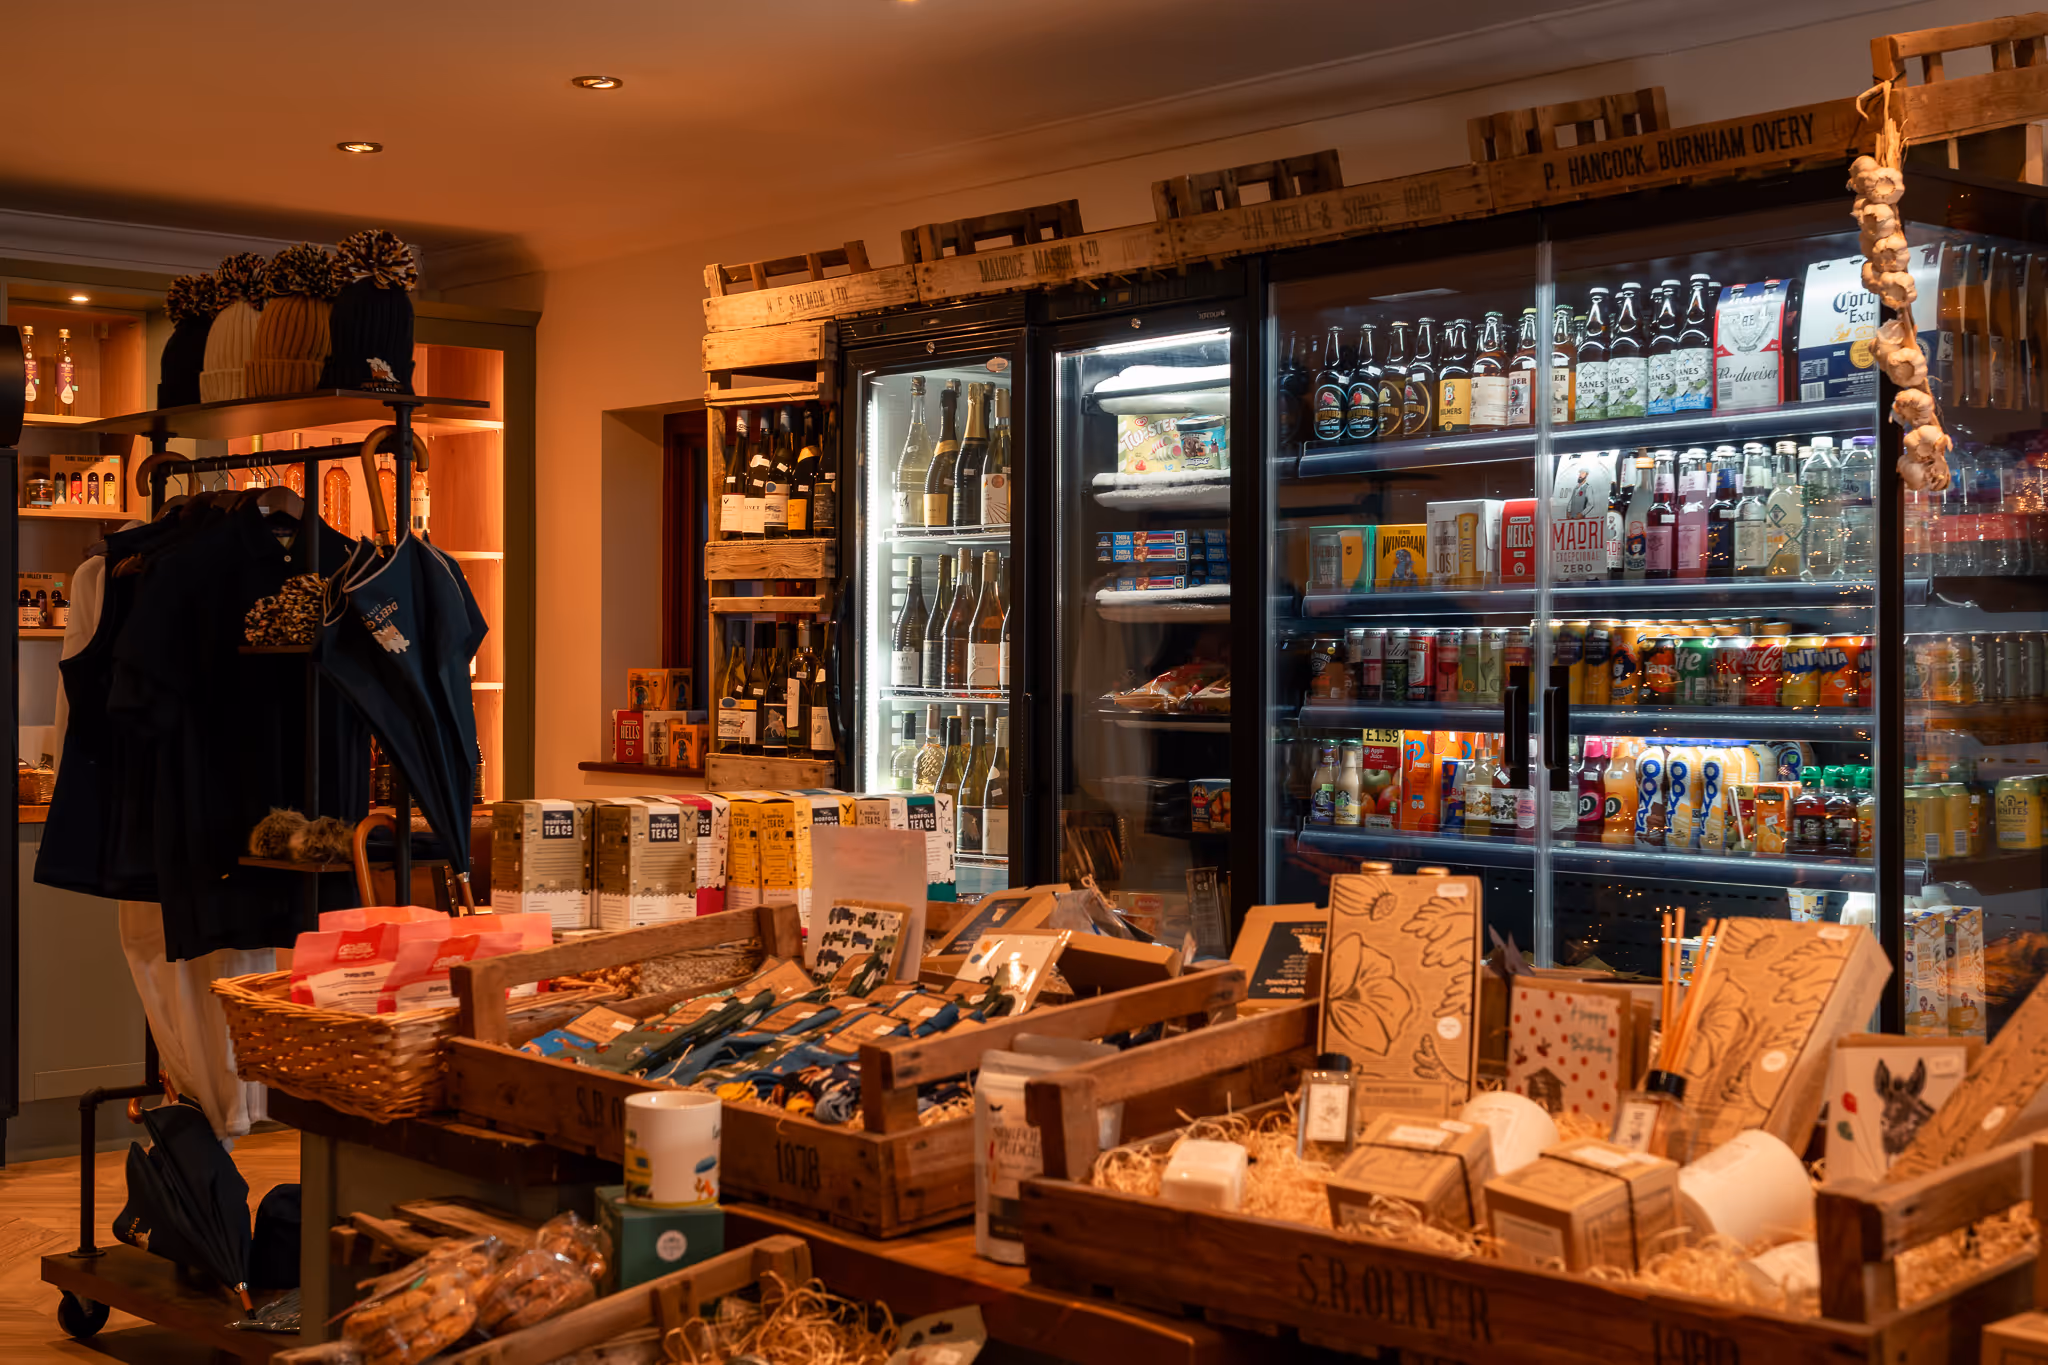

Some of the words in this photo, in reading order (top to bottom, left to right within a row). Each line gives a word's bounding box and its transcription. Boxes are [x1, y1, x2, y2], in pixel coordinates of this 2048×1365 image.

[1567, 145, 1648, 187] HANCOCK
[1657, 126, 1746, 171] BURNHAM
[1752, 113, 1814, 154] OVERY
[977, 252, 1025, 284] MAURICE
[789, 289, 825, 309] SALMON
[1832, 290, 1875, 314] Coro
[1849, 308, 1876, 324] Extr
[1715, 360, 1778, 383] Budweiser
[1506, 524, 1534, 548] HELLS
[1382, 535, 1426, 560] WINGMAN
[1435, 552, 1457, 574] LOST
[1563, 564, 1593, 573] ZERO
[620, 724, 640, 740] HELLS
[1365, 728, 1400, 743] £1.59
[814, 815, 838, 823] NORFOLK
[910, 820, 925, 829] TEA
[545, 826, 561, 836] TEA
[651, 829, 667, 839] TEA
